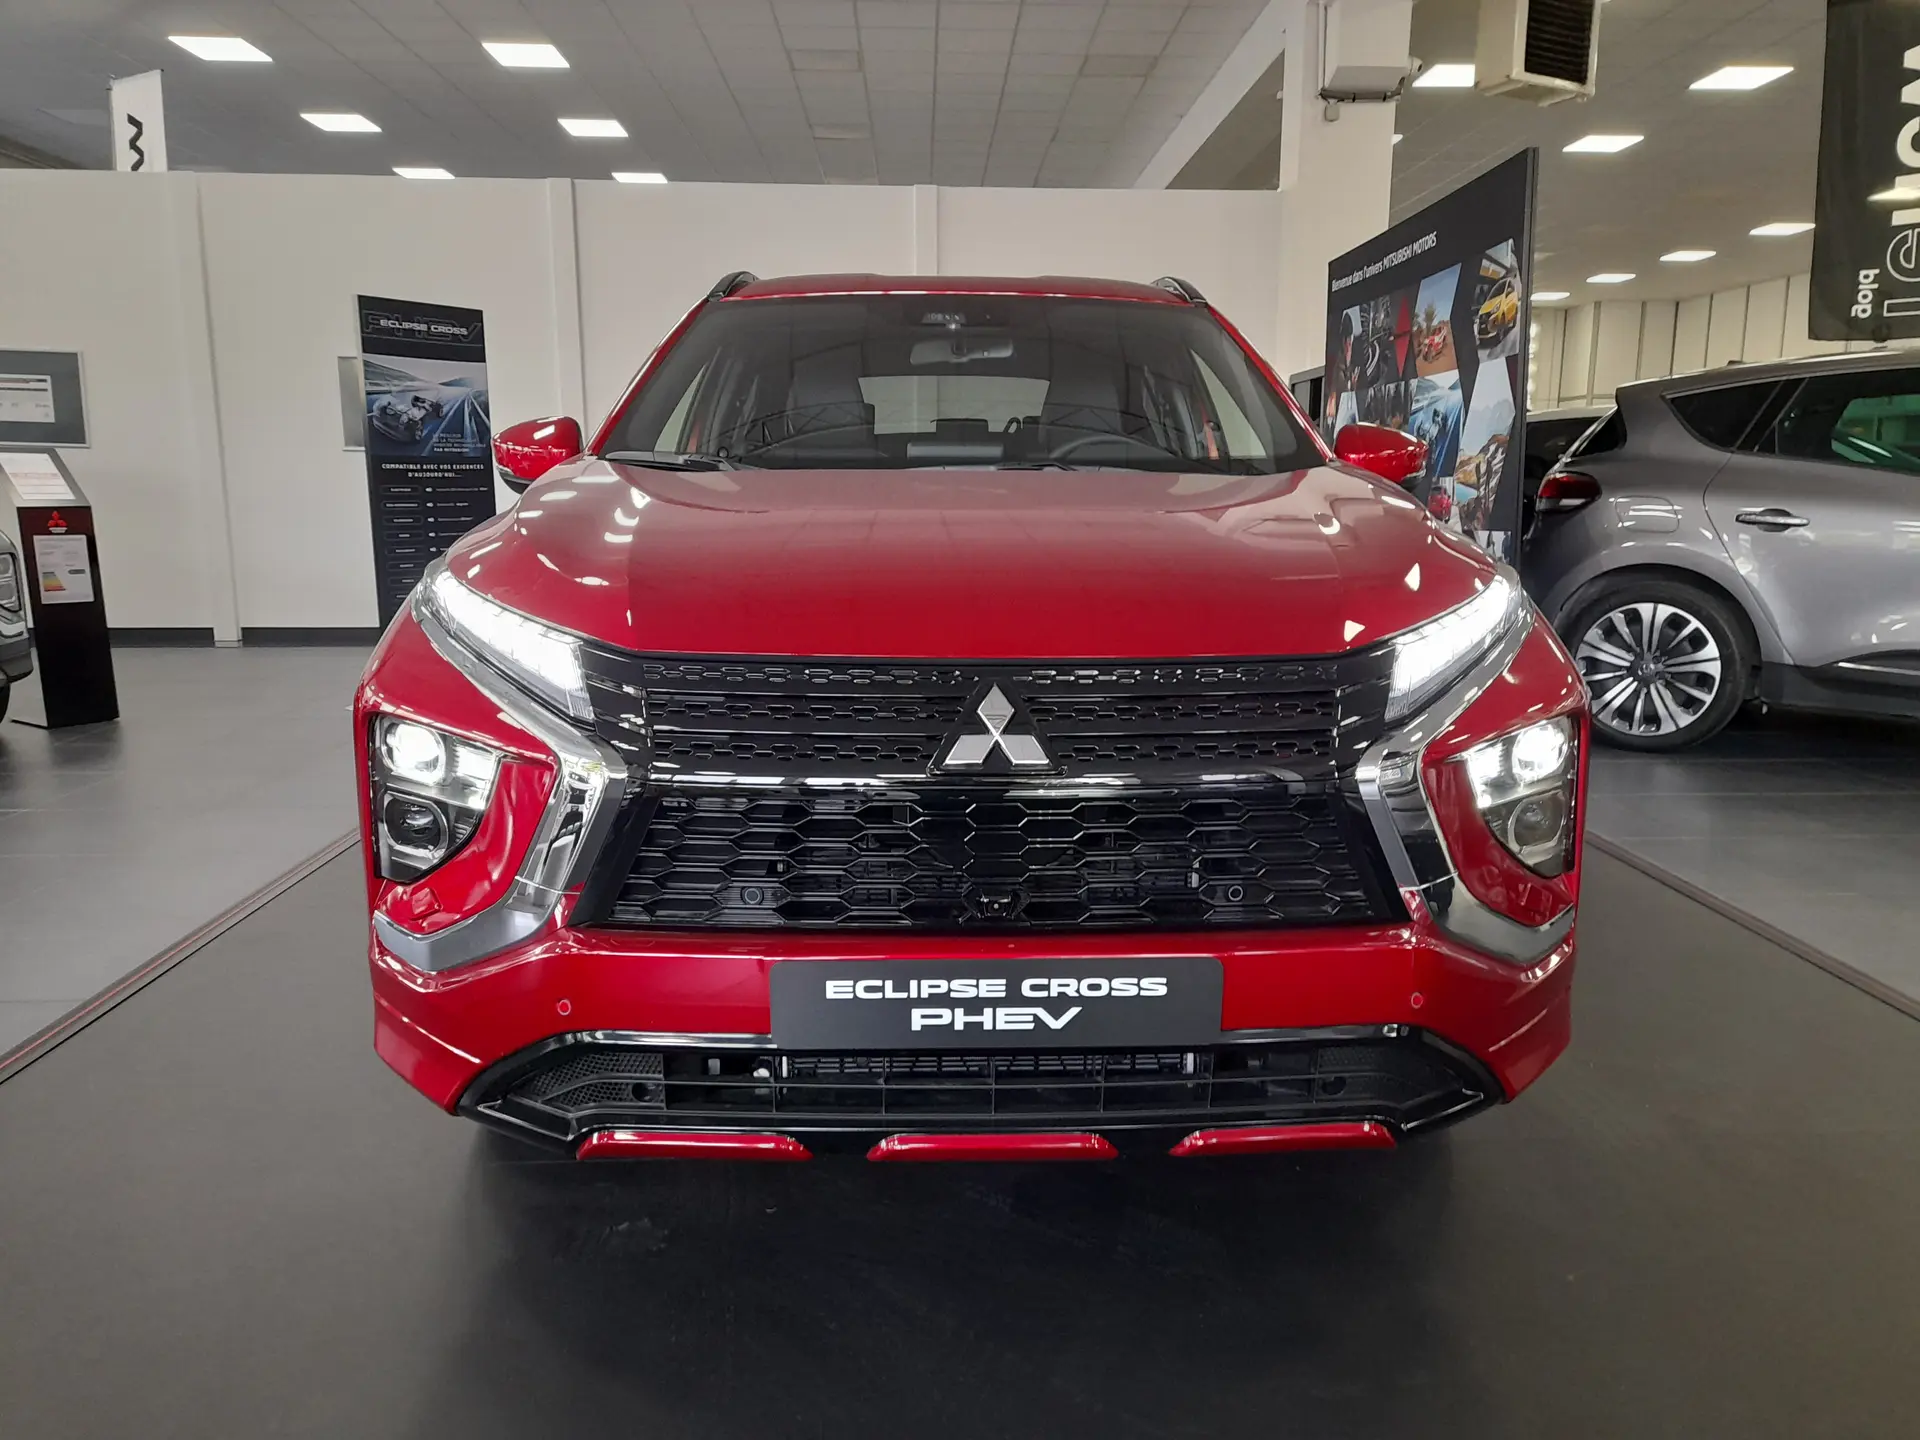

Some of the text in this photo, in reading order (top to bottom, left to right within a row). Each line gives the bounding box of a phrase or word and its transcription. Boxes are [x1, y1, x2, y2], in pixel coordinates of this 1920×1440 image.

[1332, 231, 1437, 292] Bienvenue dans l'univers MITSUBISHI MOTORS
[380, 319, 468, 335] ECLIPSE CROSS
[826, 977, 1168, 999] ECLIPSE CROSS
[911, 1007, 1083, 1031] PHEV
